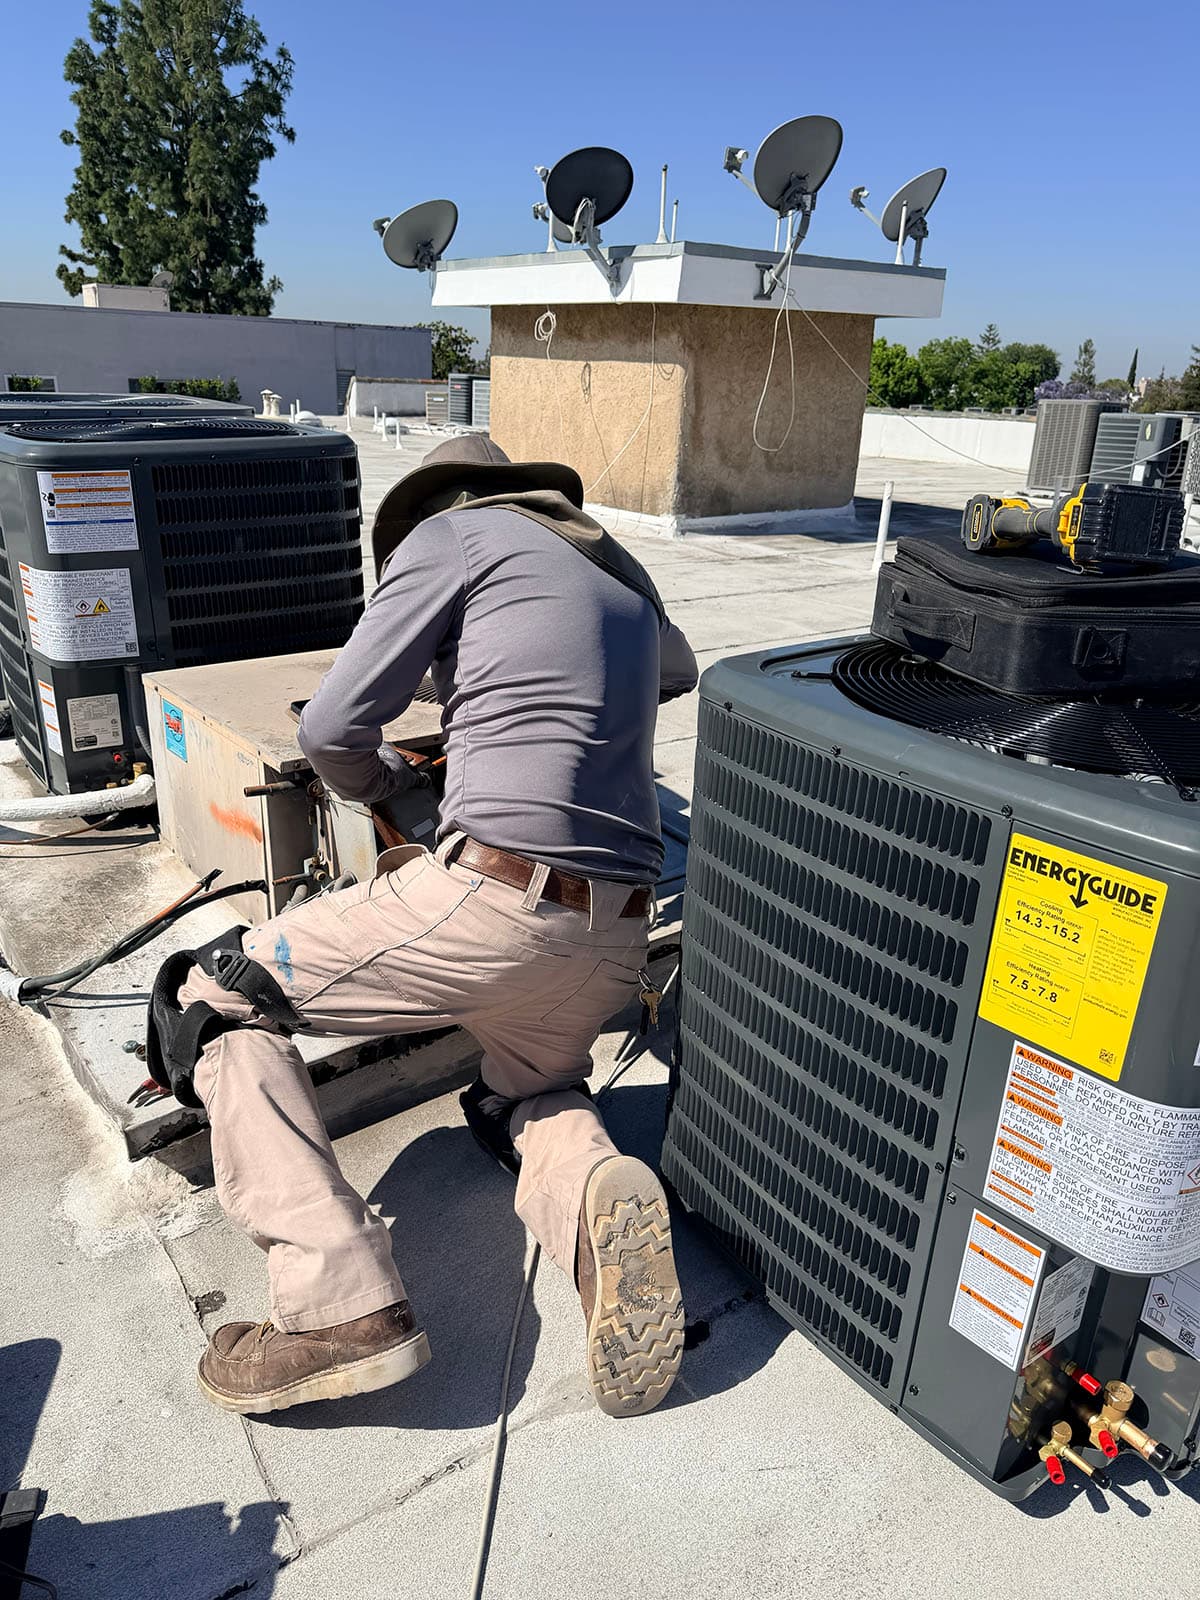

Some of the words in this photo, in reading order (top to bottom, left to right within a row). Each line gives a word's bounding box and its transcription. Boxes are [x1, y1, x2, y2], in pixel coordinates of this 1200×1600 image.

[1010, 848, 1157, 915] ENERGYGUIDE
[1040, 900, 1063, 914] Cooling
[1017, 900, 1045, 916] Efficiency
[1046, 911, 1066, 924] Rating
[1006, 961, 1033, 977] Efficiency
[1035, 973, 1053, 986] Rating
[1028, 962, 1050, 977] Heating
[1027, 1051, 1071, 1079] WARNING
[1078, 1077, 1101, 1094] RISK
[1103, 1090, 1118, 1100] OF
[1120, 1097, 1144, 1112] FIRE
[1047, 1071, 1059, 1083] TO
[1062, 1080, 1075, 1090] BE
[1077, 1087, 1127, 1115] REPAIRED
[1130, 1112, 1160, 1126] ONLY
[1162, 1120, 1178, 1130] BY
[1004, 1108, 1045, 1136] FEDERAL
[1048, 1132, 1062, 1144] OR
[1064, 1140, 1095, 1161] LOCAL
[1006, 1101, 1018, 1110] OF
[1020, 1108, 1070, 1138] PROPERLY
[1071, 1134, 1082, 1144] IN
[1082, 1141, 1155, 1175] ACCORDANCE
[1017, 1098, 1062, 1125] WARNING
[1066, 1123, 1088, 1139] RISK
[1090, 1136, 1105, 1146] OF
[1106, 1144, 1130, 1159] FIRE
[1140, 1156, 1186, 1169] DISPOSE
[1076, 1095, 1090, 1106] DO
[1092, 1102, 1113, 1118] NOT
[1115, 1114, 1175, 1138] PUNCTURE
[1003, 1117, 1057, 1150] FLAMMABLE
[1058, 1147, 1129, 1186] REFRIGERANT
[1130, 1182, 1162, 1194] USED.
[1008, 1144, 1050, 1172] WARNING
[1056, 1171, 1077, 1188] RISK
[1080, 1184, 1094, 1195] OF
[1095, 1192, 1119, 1207] FIRE
[1127, 1206, 1180, 1217] AUXILIARY
[994, 1164, 1012, 1178] USE
[1013, 1174, 1037, 1192] WITH
[1040, 1189, 1057, 1204] THE
[1059, 1200, 1102, 1229] SPECIFIC
[1104, 1225, 1164, 1242] APPLIANCE.
[1167, 1232, 1184, 1241] SEE
[998, 1148, 1009, 1160] BE
[1011, 1156, 1051, 1181] IGNITION
[1053, 1178, 1098, 1208] SOURCES
[1100, 1204, 1135, 1221] SHALL
[1136, 1216, 1160, 1226] NOT
[1052, 1187, 1084, 1209] OTHER
[1088, 1206, 1114, 1224] THAN
[1115, 1221, 1169, 1234] AUXILIARY
